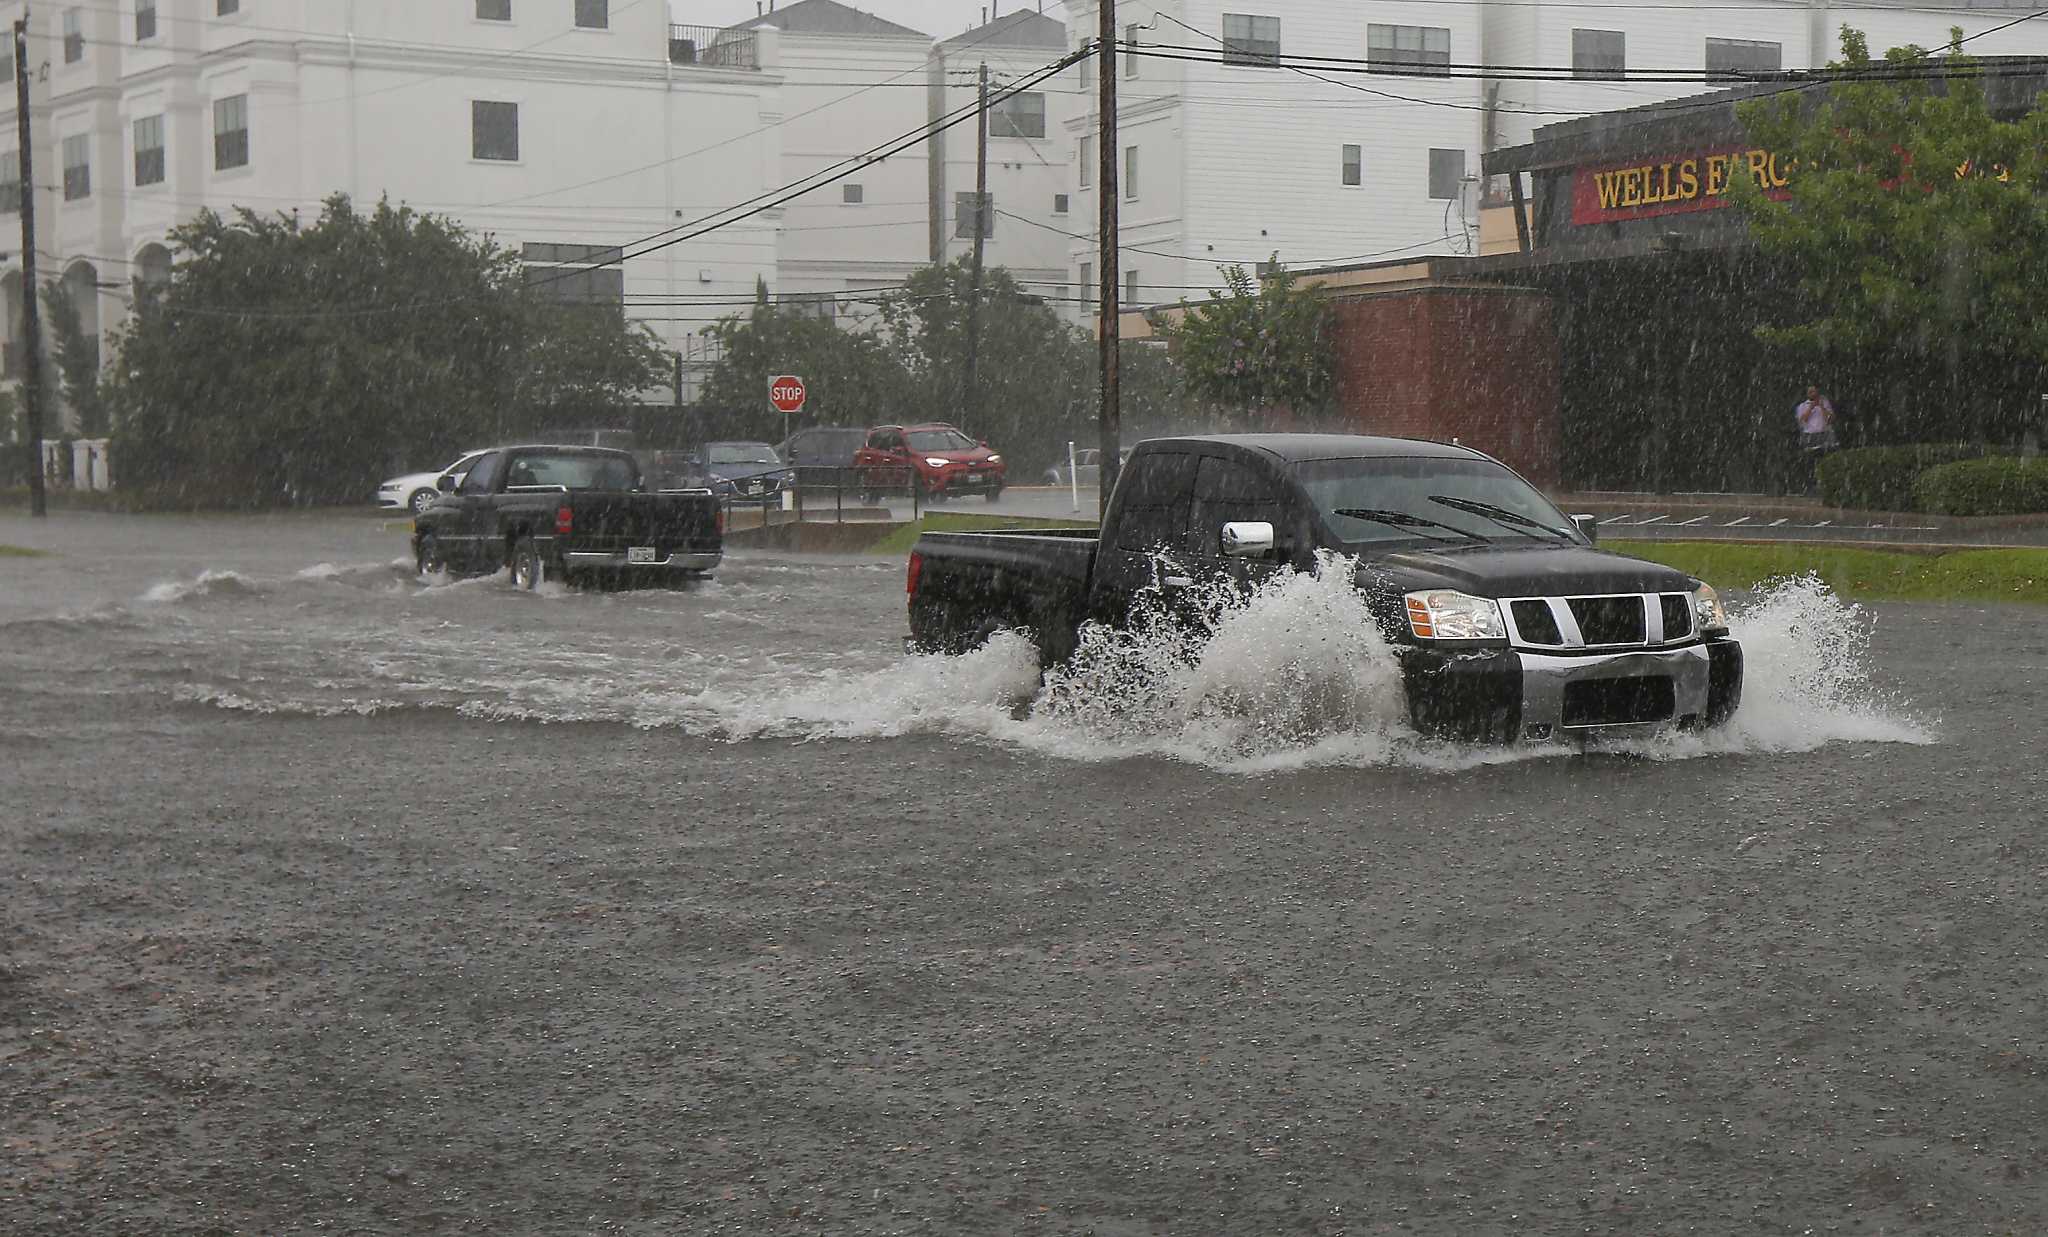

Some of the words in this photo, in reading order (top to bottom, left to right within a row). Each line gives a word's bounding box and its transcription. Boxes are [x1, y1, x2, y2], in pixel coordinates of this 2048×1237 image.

[1593, 159, 1699, 209] WELLS
[1705, 149, 1815, 196] FARG
[773, 387, 802, 400] STOP
